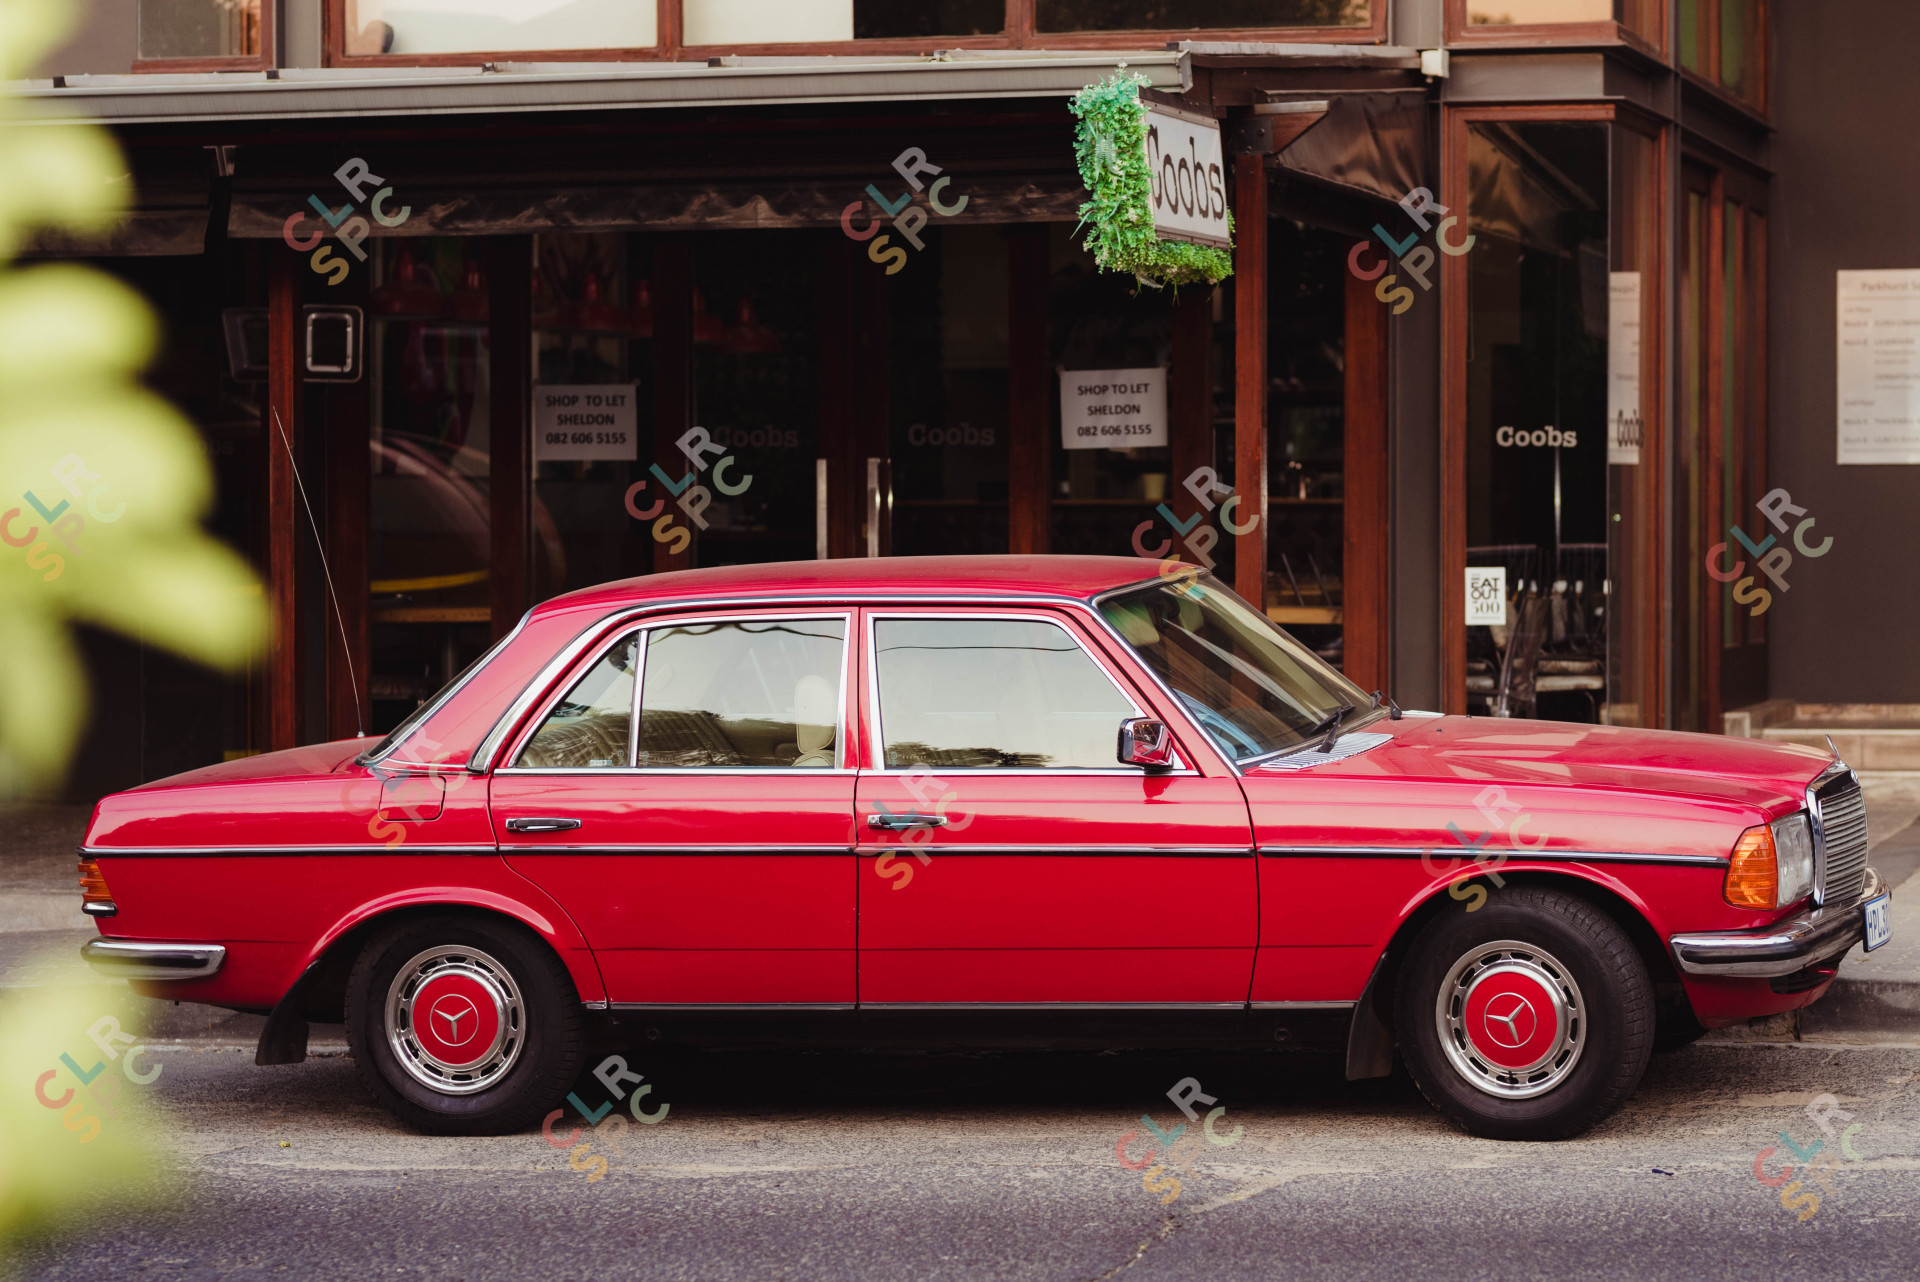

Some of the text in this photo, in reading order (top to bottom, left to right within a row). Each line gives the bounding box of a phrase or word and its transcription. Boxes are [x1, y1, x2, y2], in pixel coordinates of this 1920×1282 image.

[1147, 123, 1225, 221] Coobs
[1077, 383, 1150, 396] SHOP TO LET
[545, 394, 626, 407] SHOP TO LET
[1087, 404, 1141, 416] SHELDON
[556, 413, 615, 426] SHELDON
[908, 423, 996, 447] Coobs
[1077, 424, 1152, 437] 082 606 5155
[1496, 426, 1577, 448] Coobs
[545, 432, 626, 444] 082 606 5155
[1471, 577, 1500, 589] EAT
[1471, 588, 1500, 600] OUT
